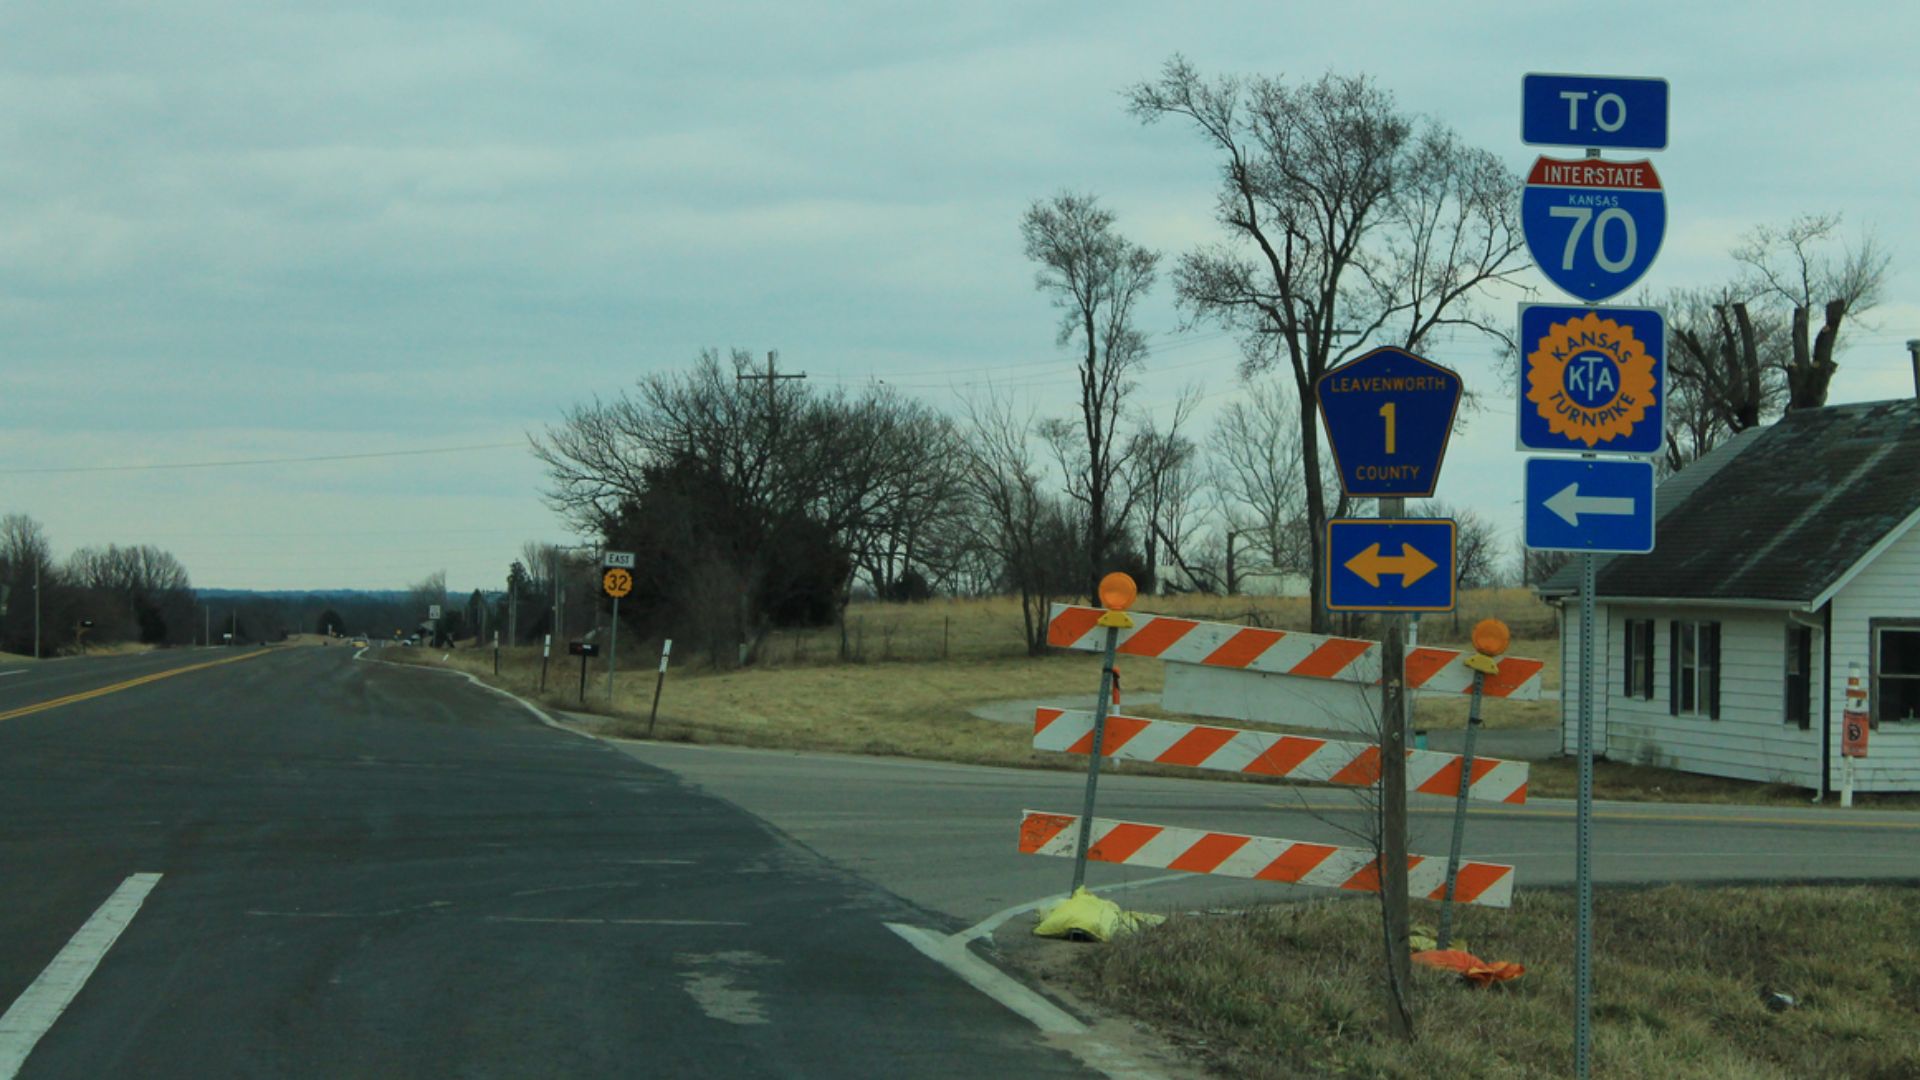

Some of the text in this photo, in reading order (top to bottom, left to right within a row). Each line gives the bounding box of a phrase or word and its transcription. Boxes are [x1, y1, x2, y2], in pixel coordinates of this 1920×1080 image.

[1559, 91, 1627, 132] TO
[1544, 165, 1644, 186] INTERSTATE
[1568, 194, 1618, 207] KANSAS
[1549, 206, 1636, 273] 70
[1551, 331, 1633, 364] KANSAS
[1331, 377, 1445, 392] LEAVENWORTH
[1569, 357, 1615, 401] KTA
[1549, 390, 1636, 427] TURNPIKE
[1379, 402, 1396, 454] 1
[1356, 466, 1419, 480] COUNTY
[609, 553, 629, 563] EAST
[608, 574, 627, 591] 32
